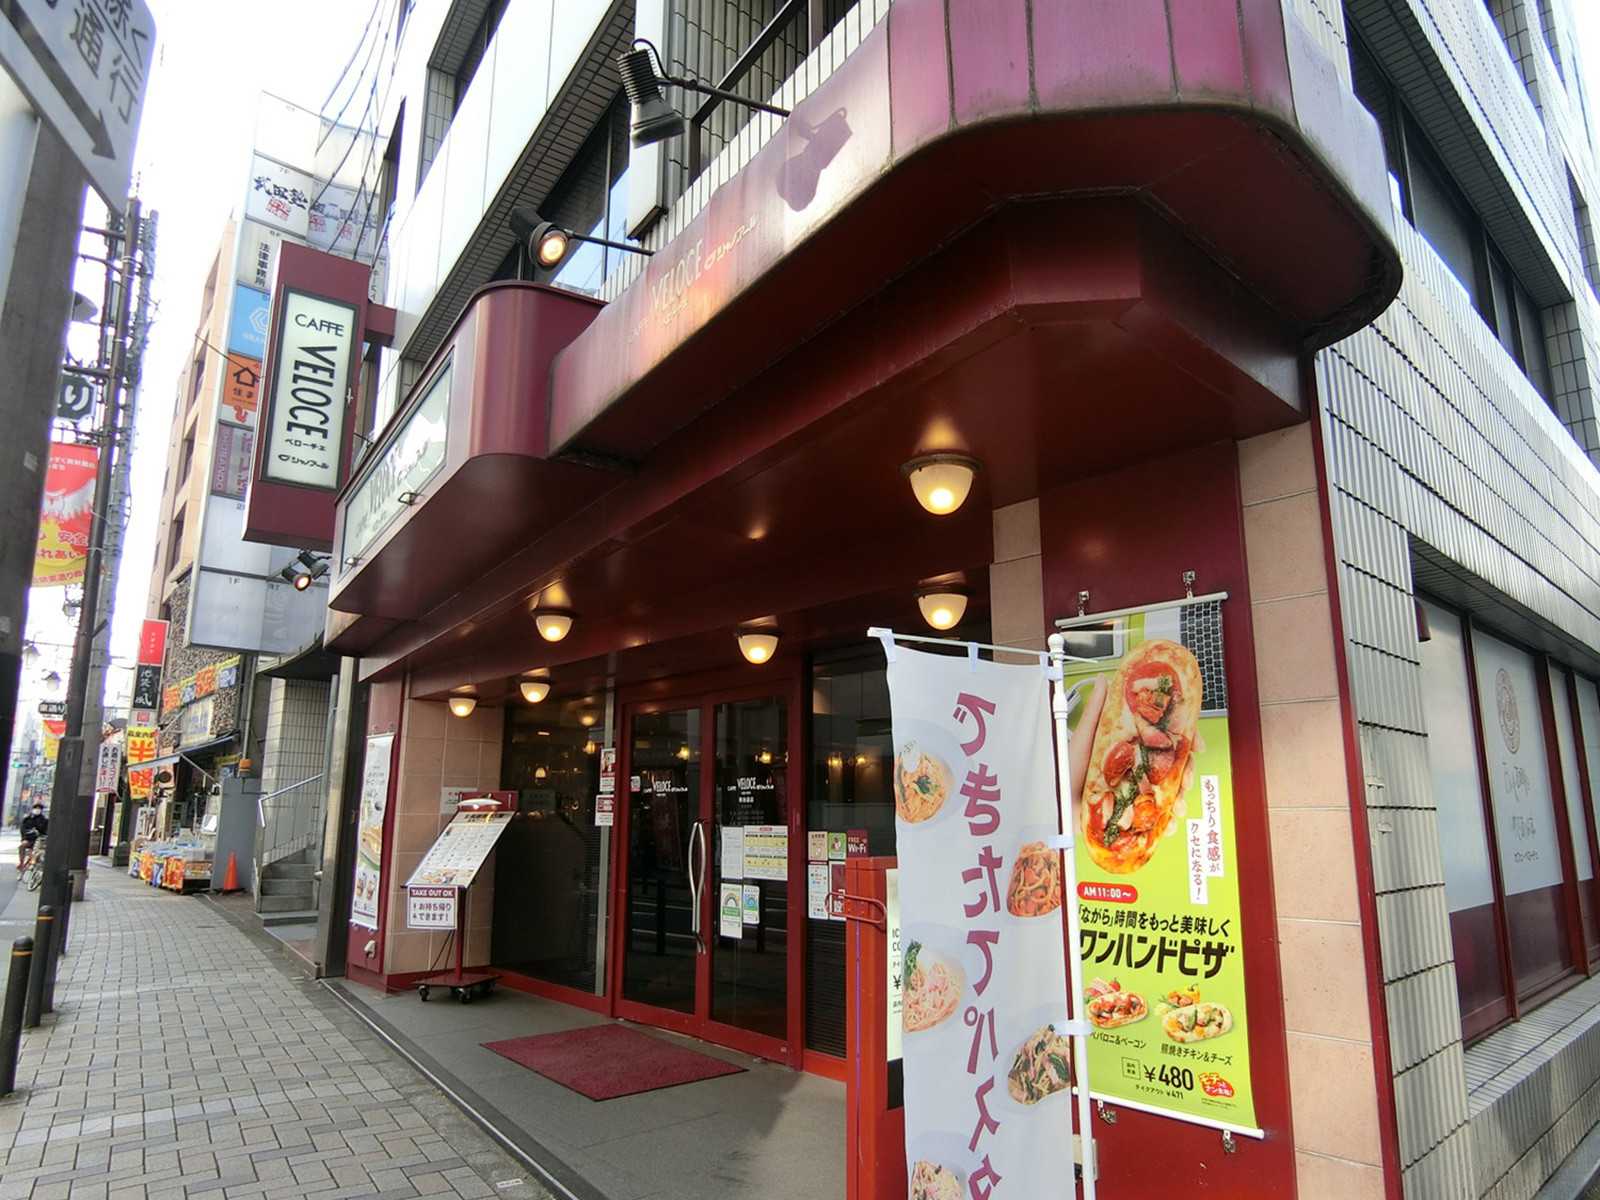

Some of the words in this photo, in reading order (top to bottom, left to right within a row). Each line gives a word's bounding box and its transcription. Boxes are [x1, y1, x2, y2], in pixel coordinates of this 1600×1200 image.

[254, 241, 270, 287] 法律事務所
[650, 239, 703, 317] VELOCE
[294, 313, 345, 337] CAFFE
[286, 345, 338, 439] VELOCE
[285, 438, 327, 452] ベローチェ
[57, 530, 89, 547] 安全
[36, 547, 82, 560] れあい
[1204, 779, 1221, 873] もっちり食感が
[1190, 822, 1204, 901] クセになる!
[411, 888, 428, 897] TAKE
[428, 888, 442, 897] OUT
[442, 889, 453, 897] OK
[418, 902, 452, 912] お持ち帰り
[418, 912, 449, 922] できます!
[1078, 904, 1231, 938] 「ながら」時間をもっと美味しく
[1080, 929, 1236, 979] ワンハンドピザ
[1160, 1042, 1233, 1066] 照焼きチキン&チーズ
[1143, 1064, 1194, 1091] ¥480
